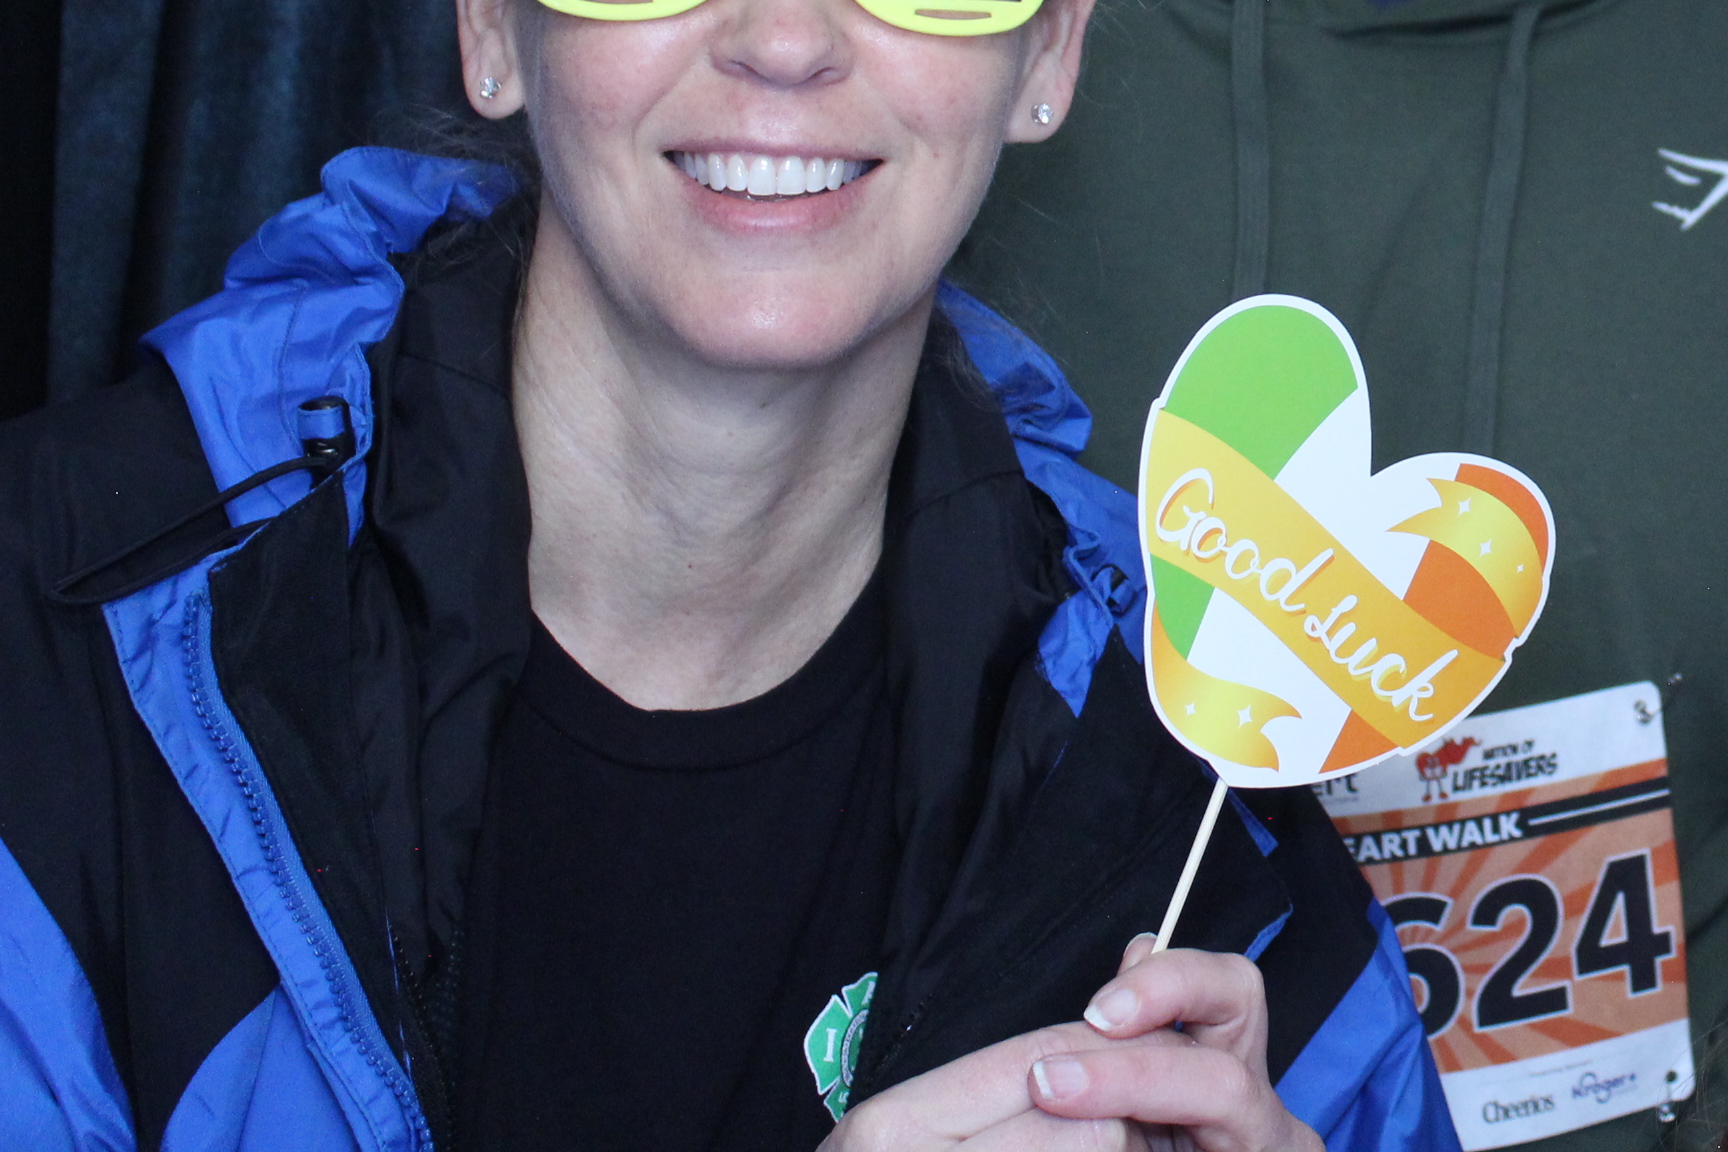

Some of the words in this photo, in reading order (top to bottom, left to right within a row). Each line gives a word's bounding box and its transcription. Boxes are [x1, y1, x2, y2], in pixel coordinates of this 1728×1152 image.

[1155, 467, 1335, 615] Good
[1303, 593, 1459, 724] Luck
[1452, 752, 1558, 794] LIFESAVERS
[1425, 811, 1523, 853] WALK
[1482, 1093, 1555, 1124] Cheerios
[1570, 1071, 1628, 1104] Kroger
